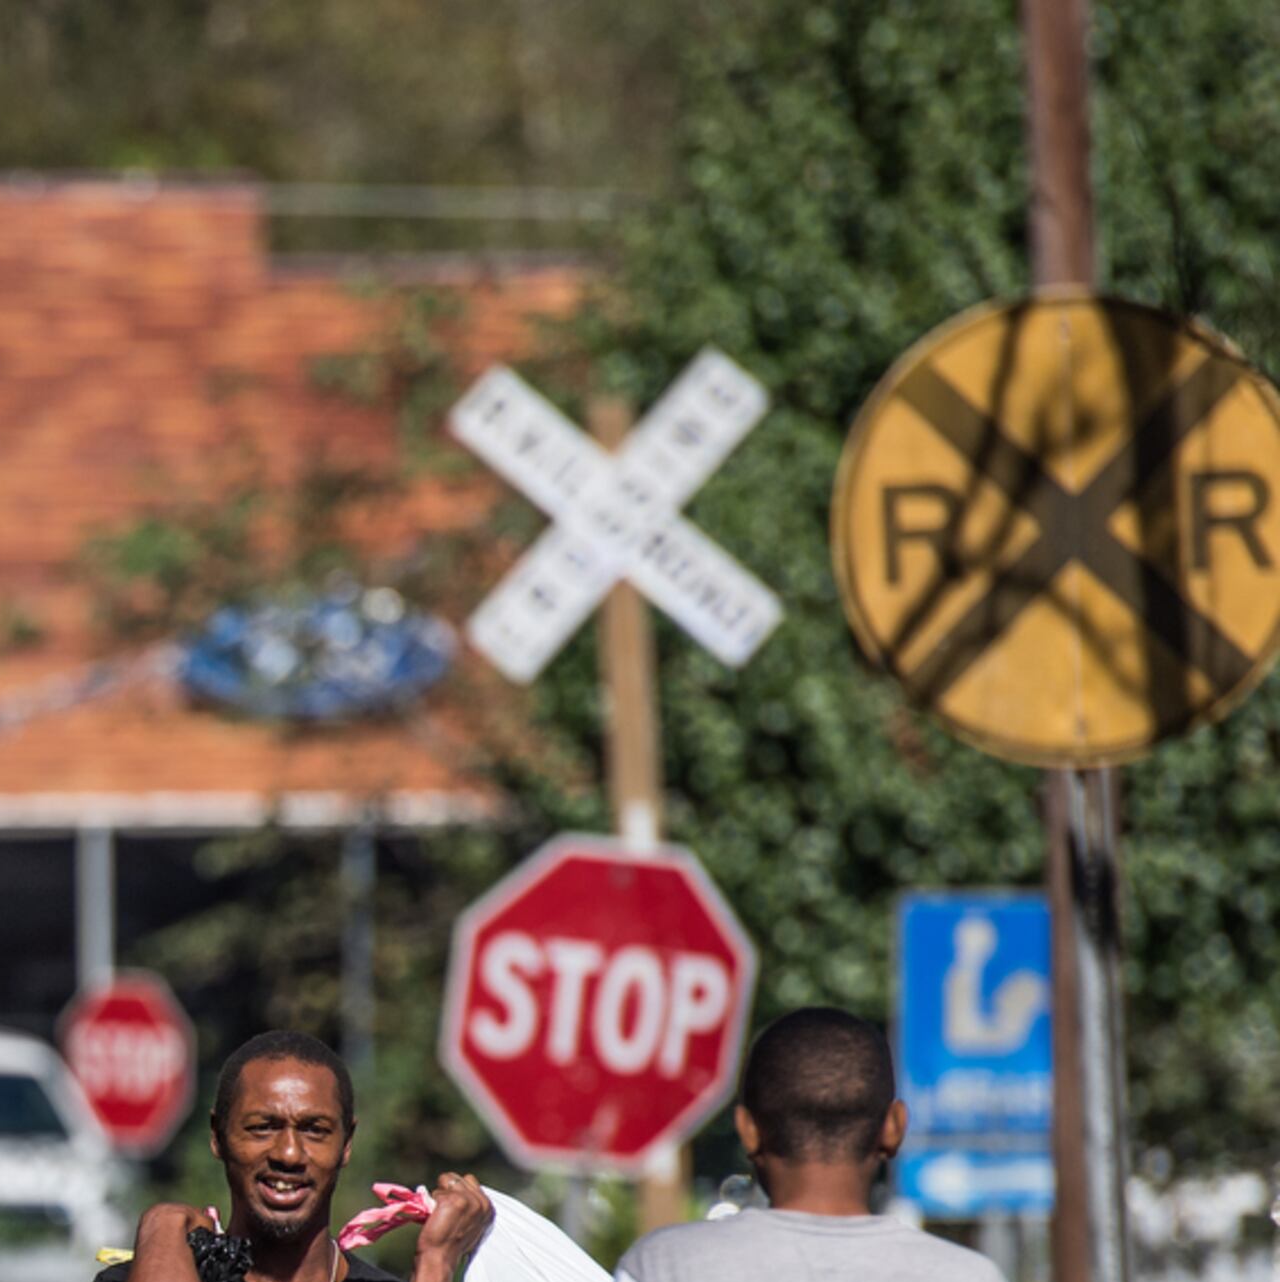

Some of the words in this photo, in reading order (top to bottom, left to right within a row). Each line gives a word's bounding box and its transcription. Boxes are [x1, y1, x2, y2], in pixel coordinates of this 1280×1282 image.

[1190, 469, 1275, 572] R
[469, 932, 732, 1077] STOP
[65, 1020, 187, 1096] STOP
